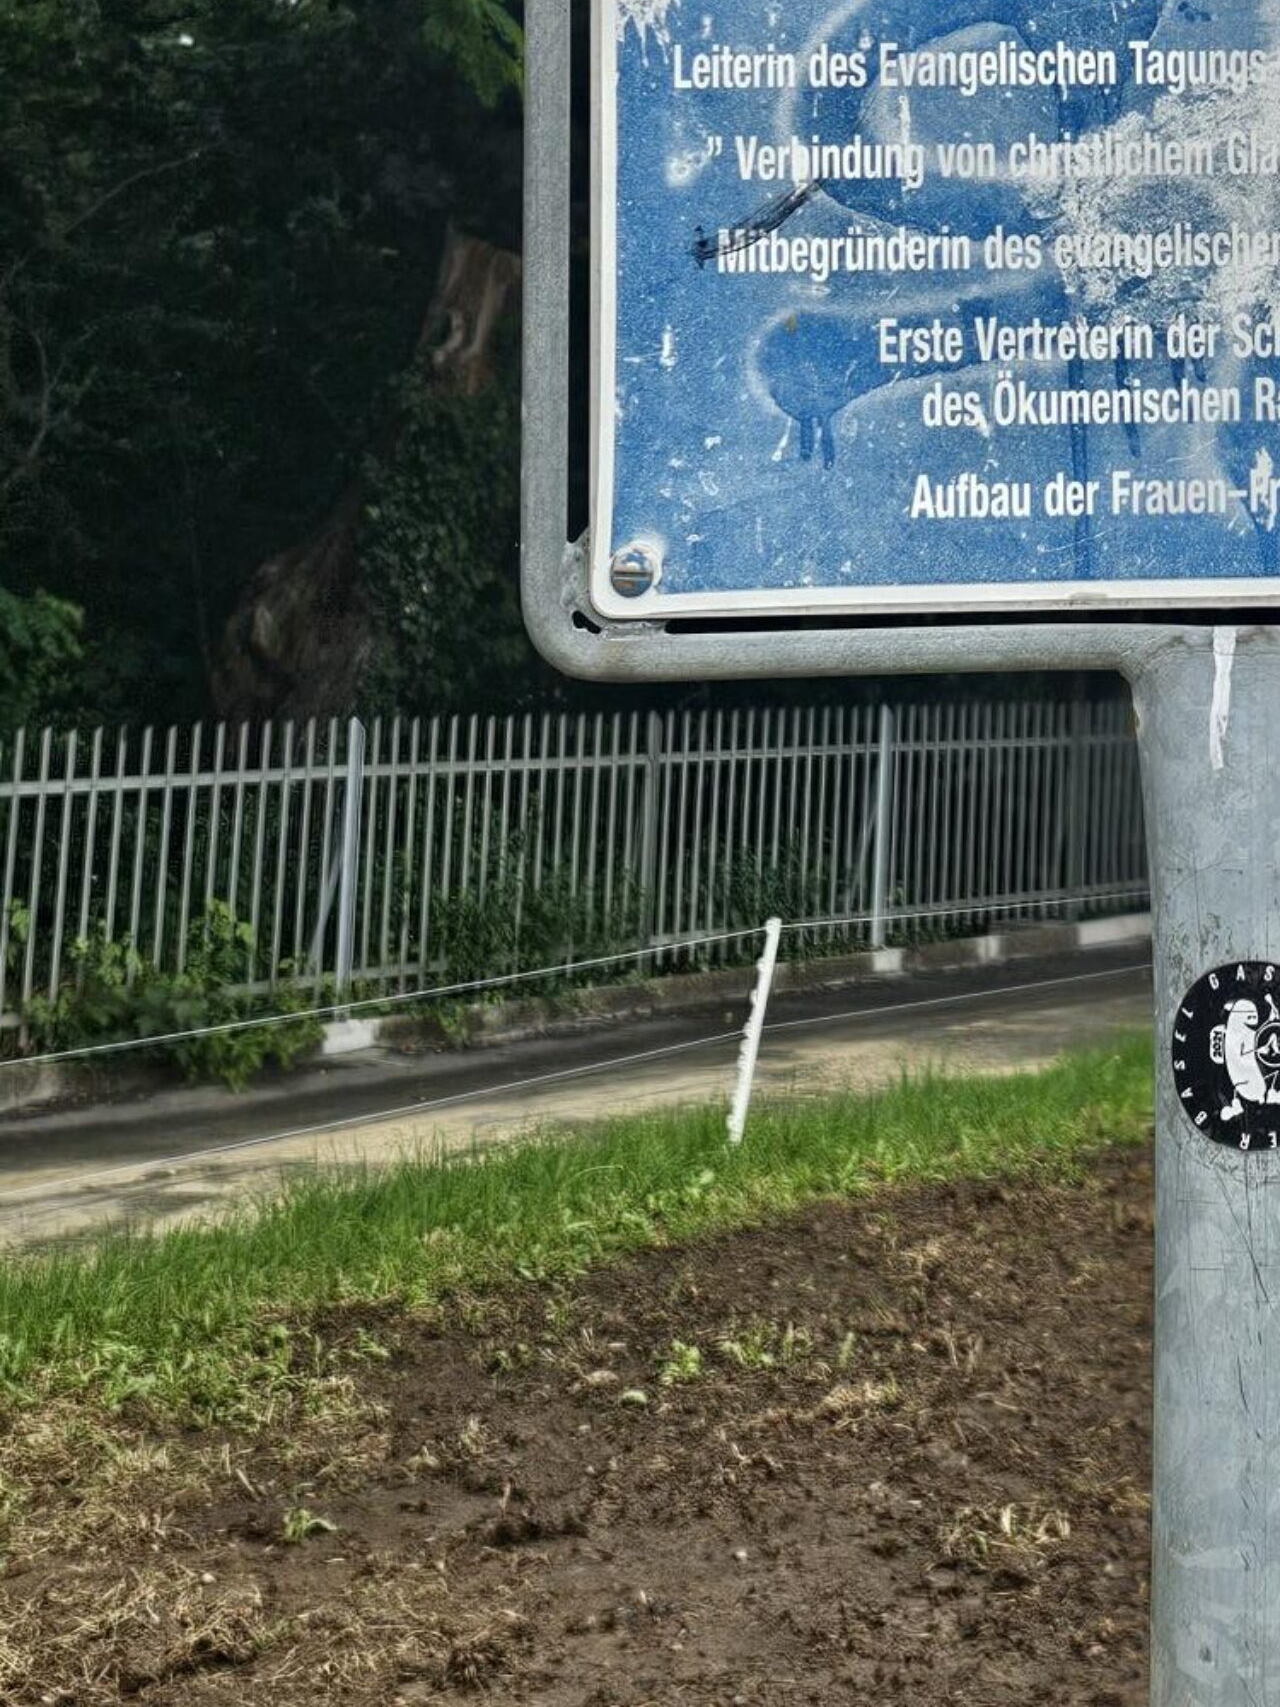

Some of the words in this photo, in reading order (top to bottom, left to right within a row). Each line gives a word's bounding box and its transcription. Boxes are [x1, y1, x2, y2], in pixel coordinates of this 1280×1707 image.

[673, 43, 796, 89] Leiterin
[809, 42, 868, 89] des
[879, 40, 1117, 96] Evangelischen
[735, 134, 925, 187] Verbindung
[937, 145, 996, 177] von
[1008, 132, 1214, 179] christlichem
[716, 228, 971, 281] Mitbegründerin
[984, 225, 1043, 270] des
[879, 318, 963, 364] Erste
[973, 316, 1153, 363] Vertreterin
[1165, 316, 1221, 359] der
[922, 381, 981, 428] des
[994, 369, 1241, 427] Ökumenischen
[910, 471, 1032, 520] Aufbau
[1043, 471, 1099, 517] der
